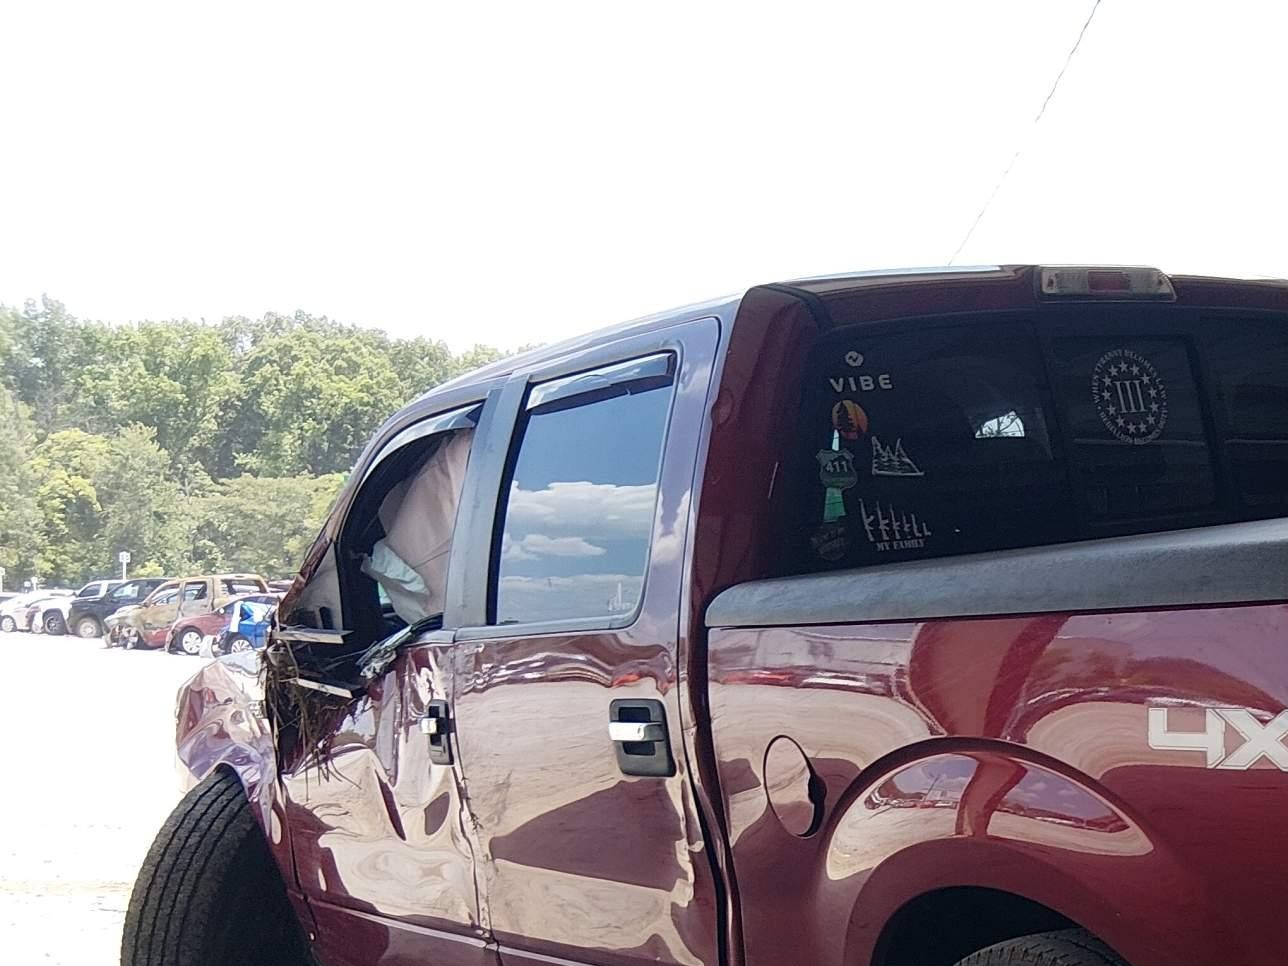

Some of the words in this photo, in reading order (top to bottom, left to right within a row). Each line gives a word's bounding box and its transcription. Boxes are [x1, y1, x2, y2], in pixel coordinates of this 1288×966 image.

[829, 374, 893, 393] VIBE
[1112, 380, 1148, 413] III
[825, 460, 848, 473] 411
